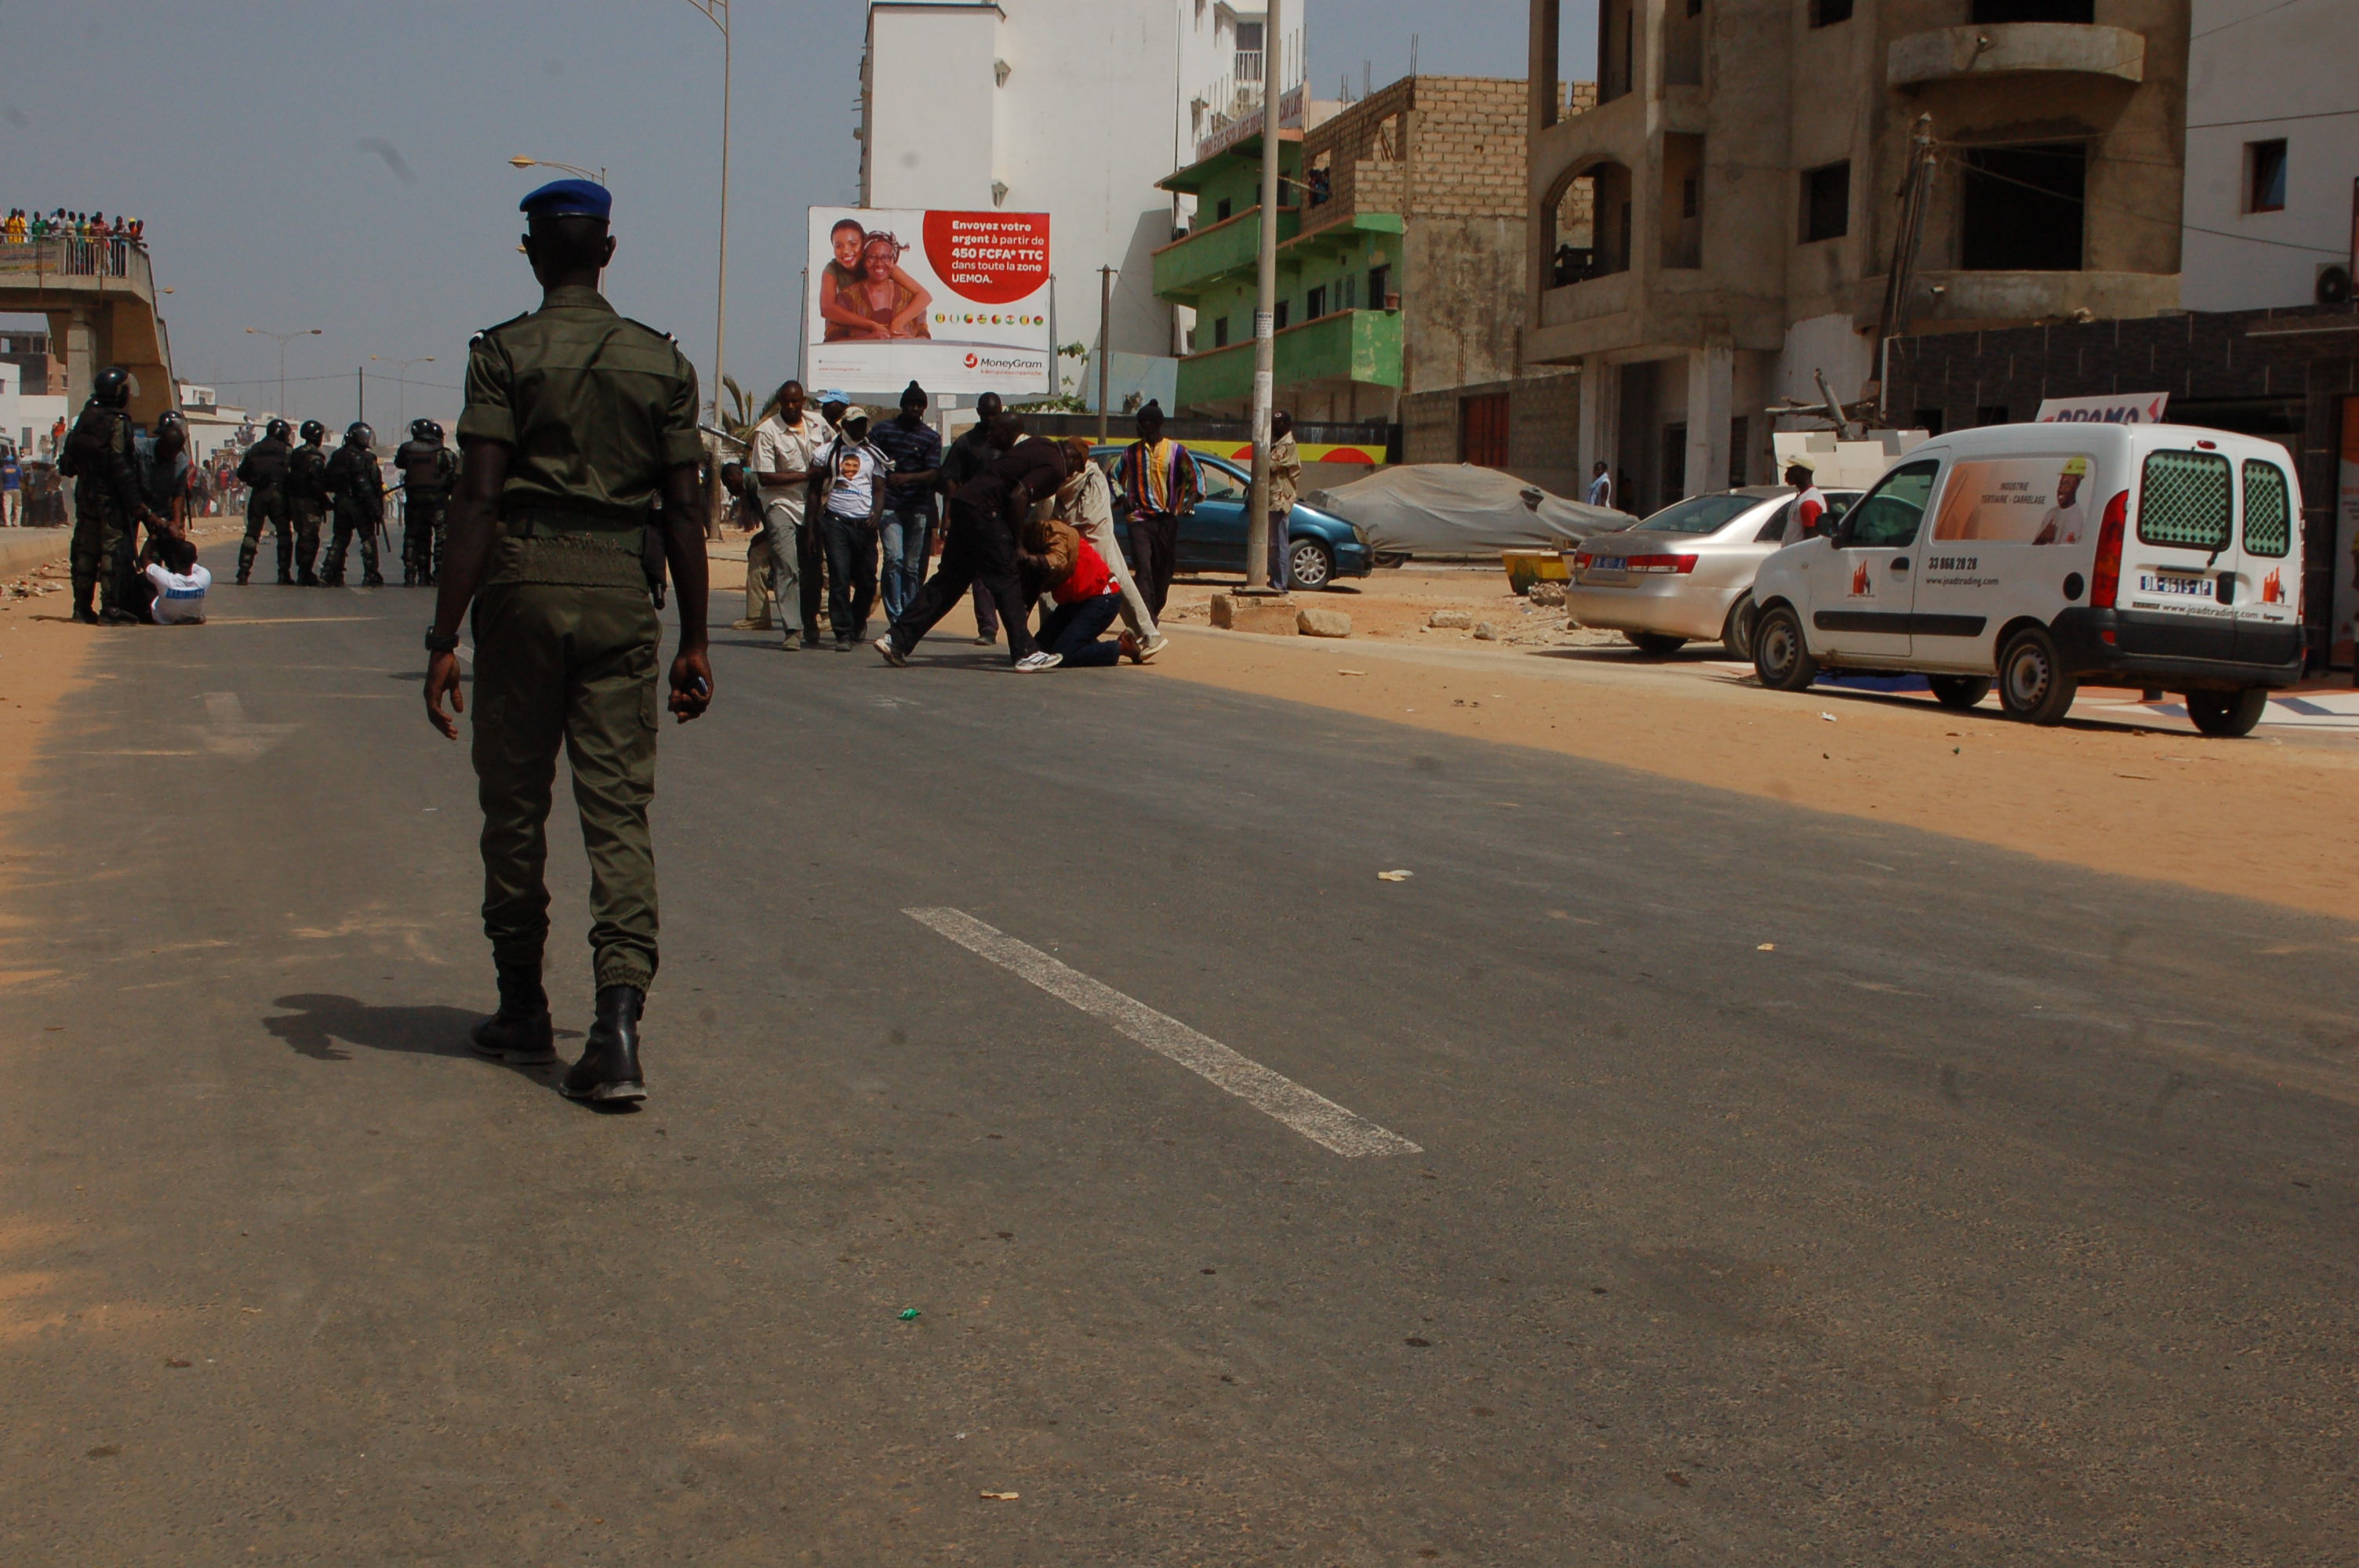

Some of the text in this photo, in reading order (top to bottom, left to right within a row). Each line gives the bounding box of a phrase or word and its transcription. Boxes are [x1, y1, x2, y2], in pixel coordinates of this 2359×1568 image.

[952, 220, 1031, 232] Envoyez votre
[951, 235, 990, 245] argent
[991, 234, 998, 244] à
[1000, 236, 1030, 246] partir
[951, 248, 977, 259] 450
[1018, 249, 1044, 261] TTC
[951, 260, 1042, 272] dans toute la zone
[951, 273, 993, 284] UEMOA.
[980, 358, 1042, 369] MoneyGram
[1928, 557, 1978, 570] 33 868 28 28
[1926, 576, 2000, 588] www.joadtrading.com
[2163, 604, 2259, 620] www.joadtrading.com
